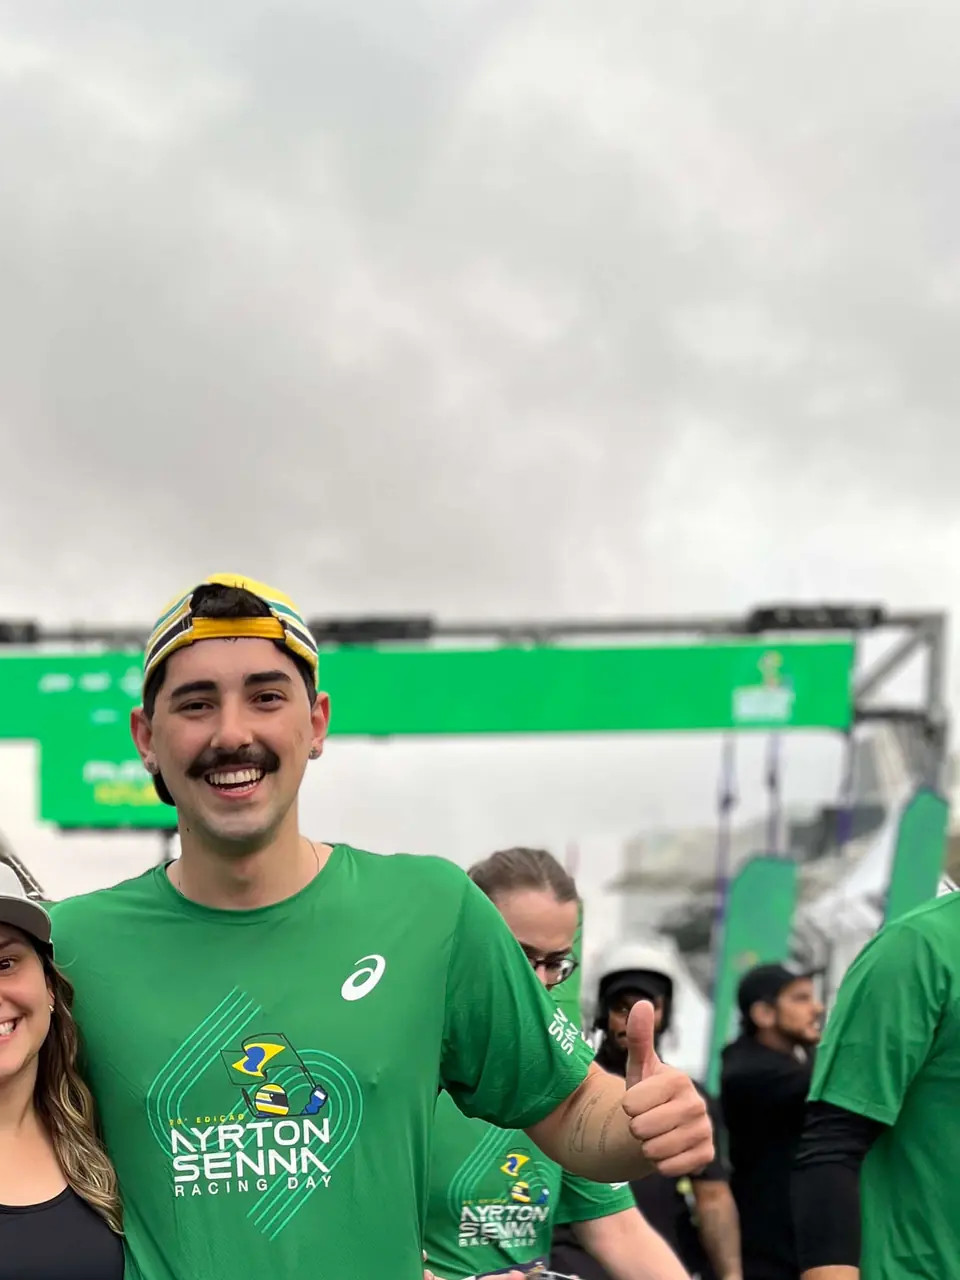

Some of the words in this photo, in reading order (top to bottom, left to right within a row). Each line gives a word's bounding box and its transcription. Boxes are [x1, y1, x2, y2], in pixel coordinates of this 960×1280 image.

[170, 1117, 330, 1154] AYRTON
[173, 1147, 330, 1183] SENNA
[175, 1178, 268, 1197] RACING
[287, 1175, 333, 1190] DAY
[460, 1204, 550, 1222] AYRTON
